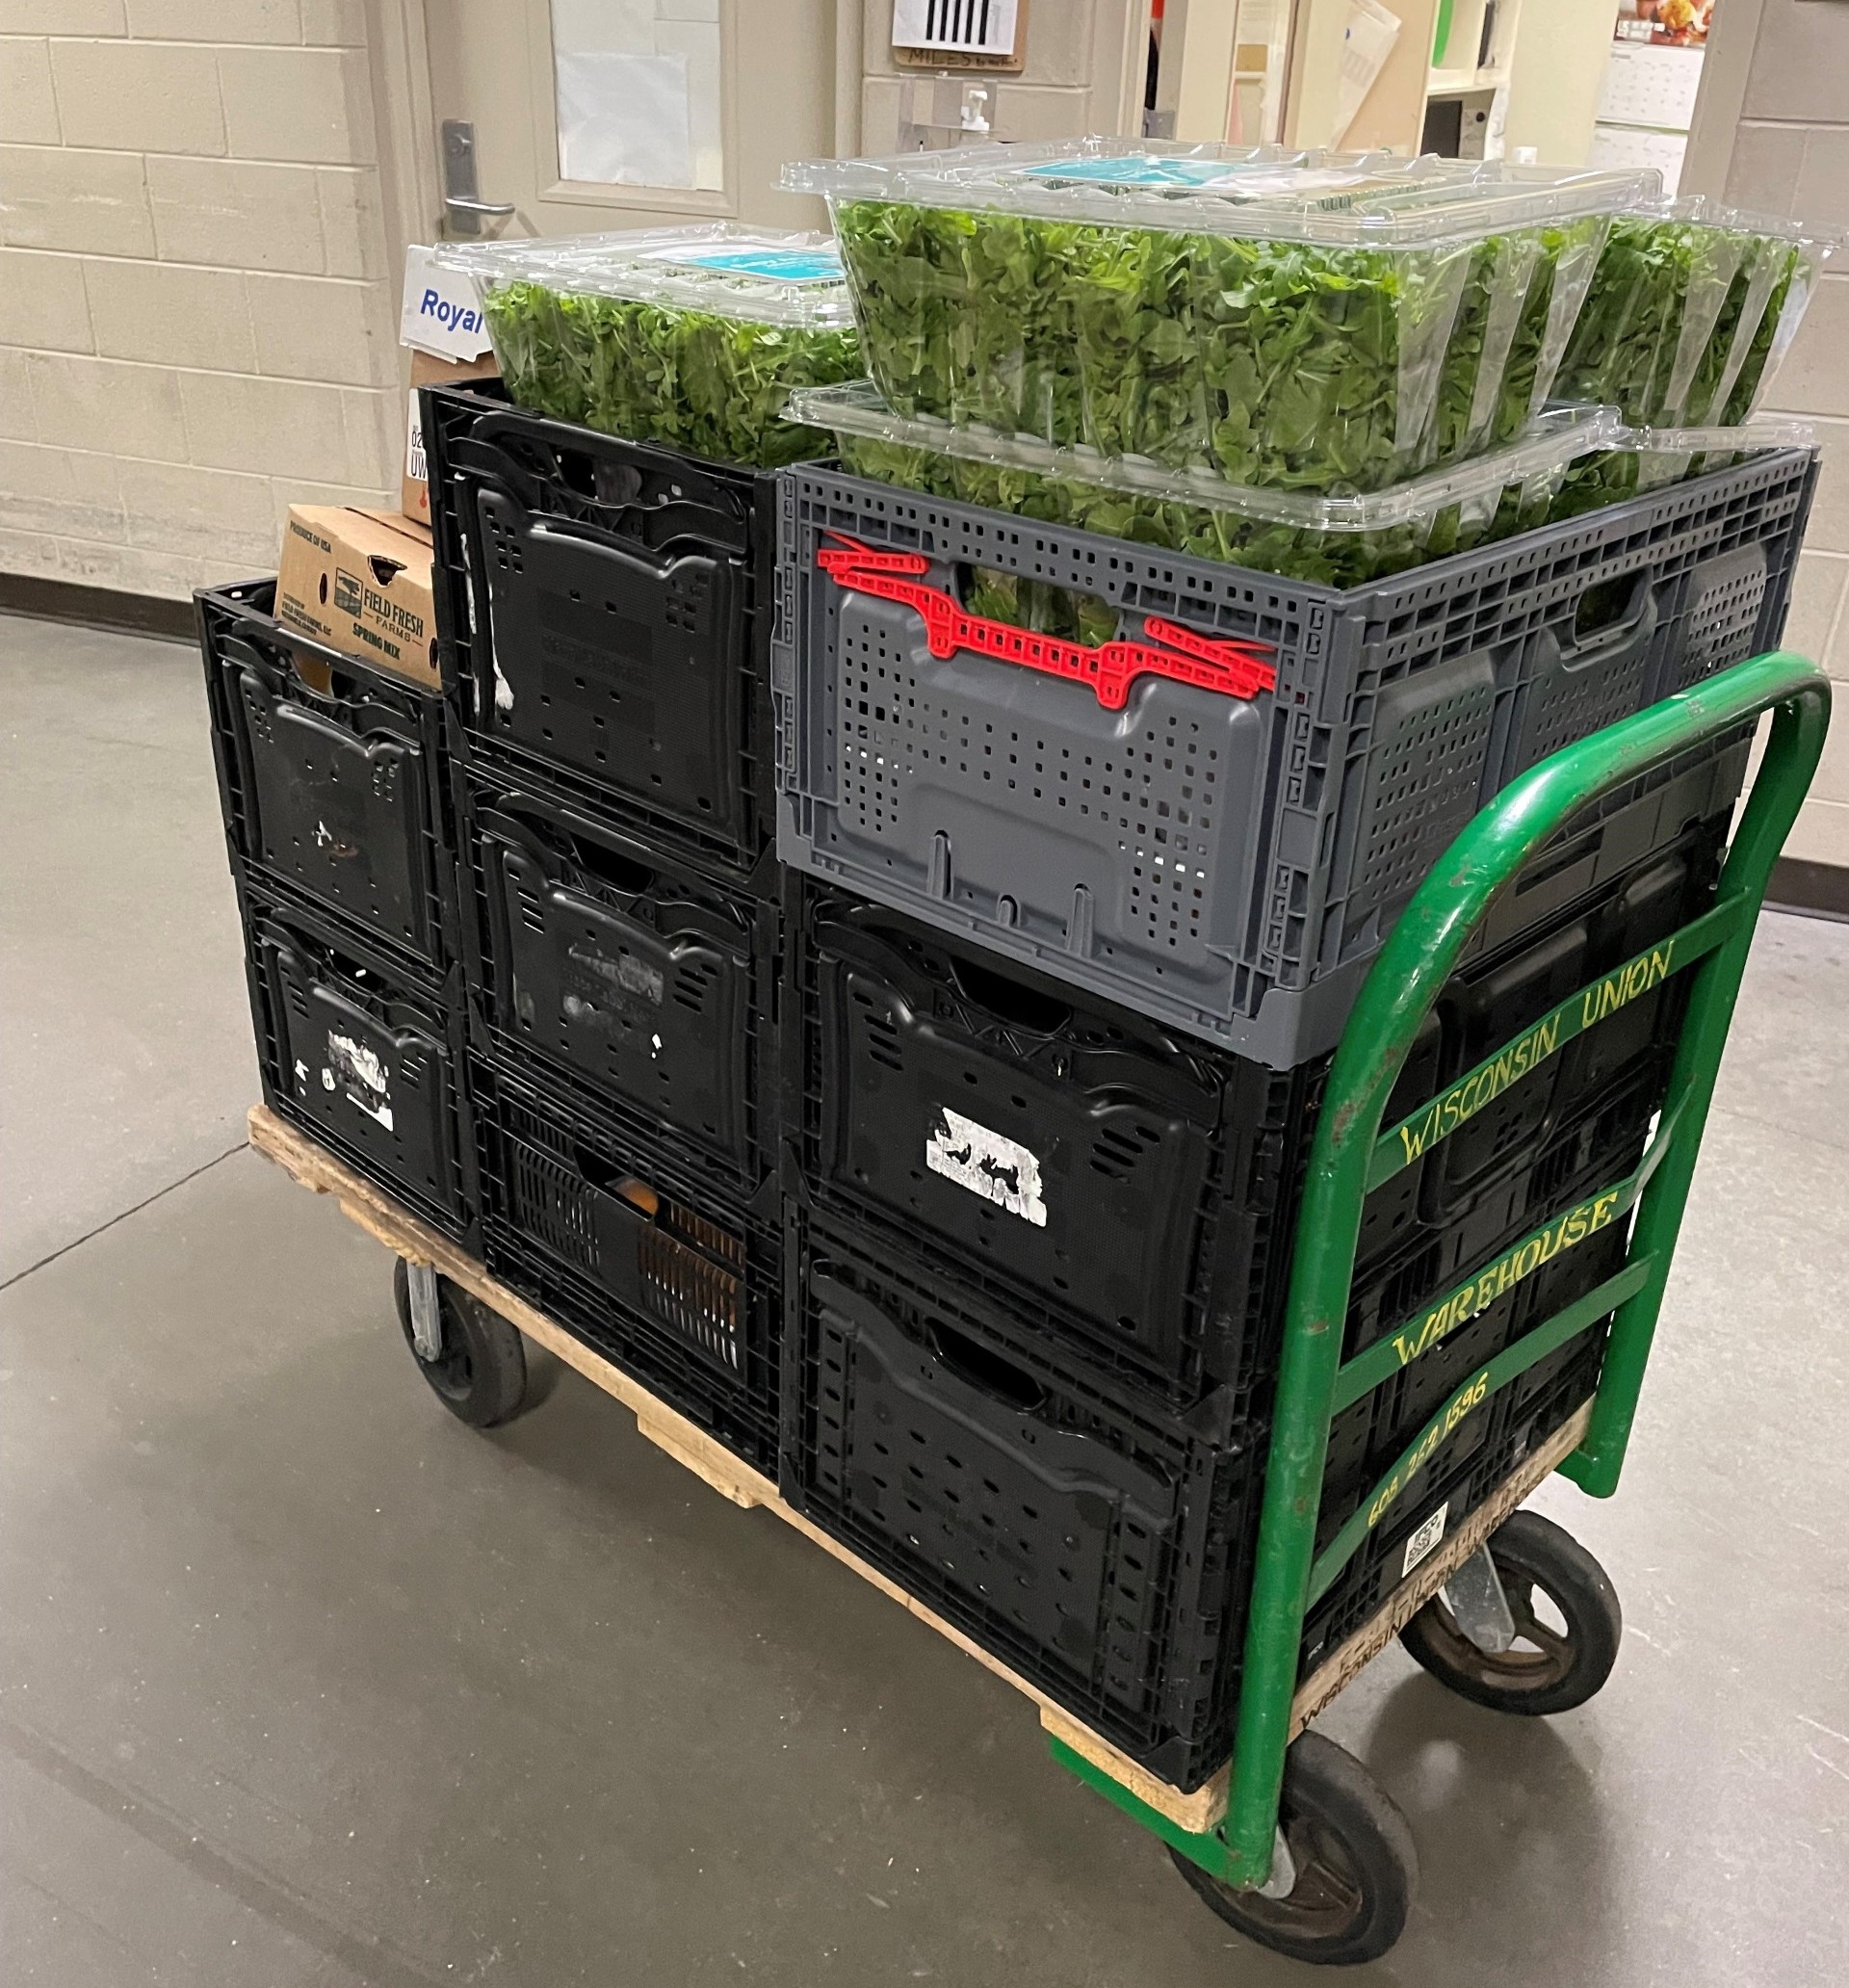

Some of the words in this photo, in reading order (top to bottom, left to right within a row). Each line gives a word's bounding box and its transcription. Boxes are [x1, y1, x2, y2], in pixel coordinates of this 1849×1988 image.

[420, 289, 483, 333] Royal
[321, 538, 331, 554] USA
[364, 588, 390, 618] FIELD
[393, 603, 423, 638] FRESH
[376, 615, 411, 642] FARMS
[352, 621, 382, 649] SPRING
[383, 640, 401, 660] MIX
[1399, 1012, 1560, 1165] WISCONSIN
[1581, 939, 1676, 1029] UNION
[1393, 1190, 1618, 1365] WAREHOUSE
[1367, 1477, 1398, 1528] 608
[1443, 1372, 1489, 1439] 1596
